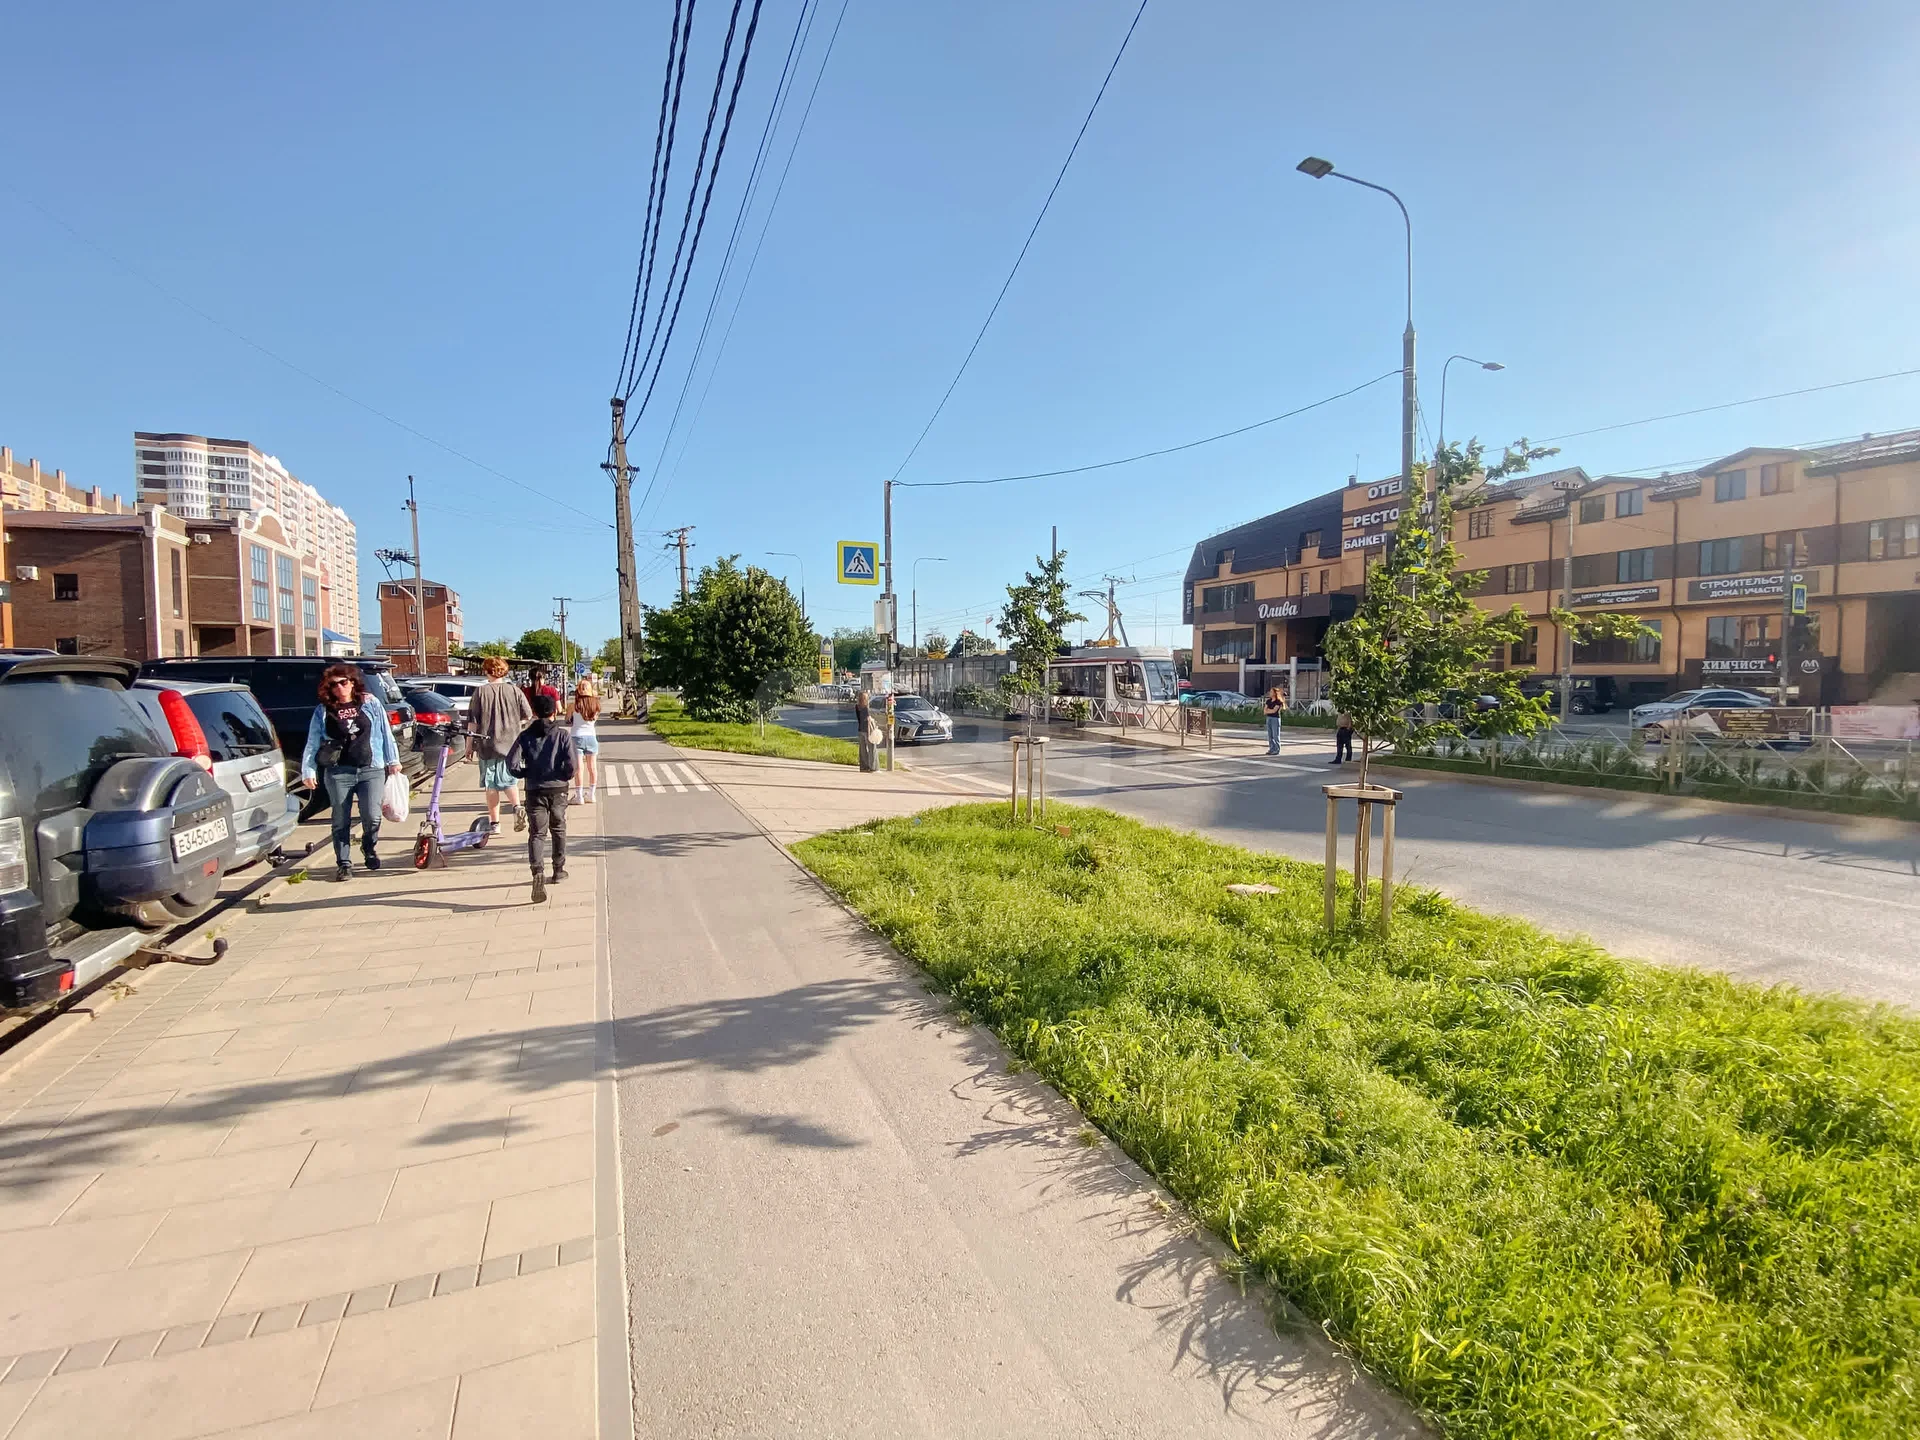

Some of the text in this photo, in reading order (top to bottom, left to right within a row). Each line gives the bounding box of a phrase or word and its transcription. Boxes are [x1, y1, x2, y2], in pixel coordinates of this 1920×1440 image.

[1368, 480, 1403, 499] ОТЕ
[1353, 501, 1433, 528] РЕСТОН
[1344, 533, 1387, 549] БАНКЕТ
[1699, 574, 1803, 590] СТРОИТЕЛЬСТО
[1709, 585, 1785, 598] ДОМА УЧАСТК
[1258, 601, 1299, 619] Олива
[1701, 659, 1783, 670] ХИМЧИСТА
